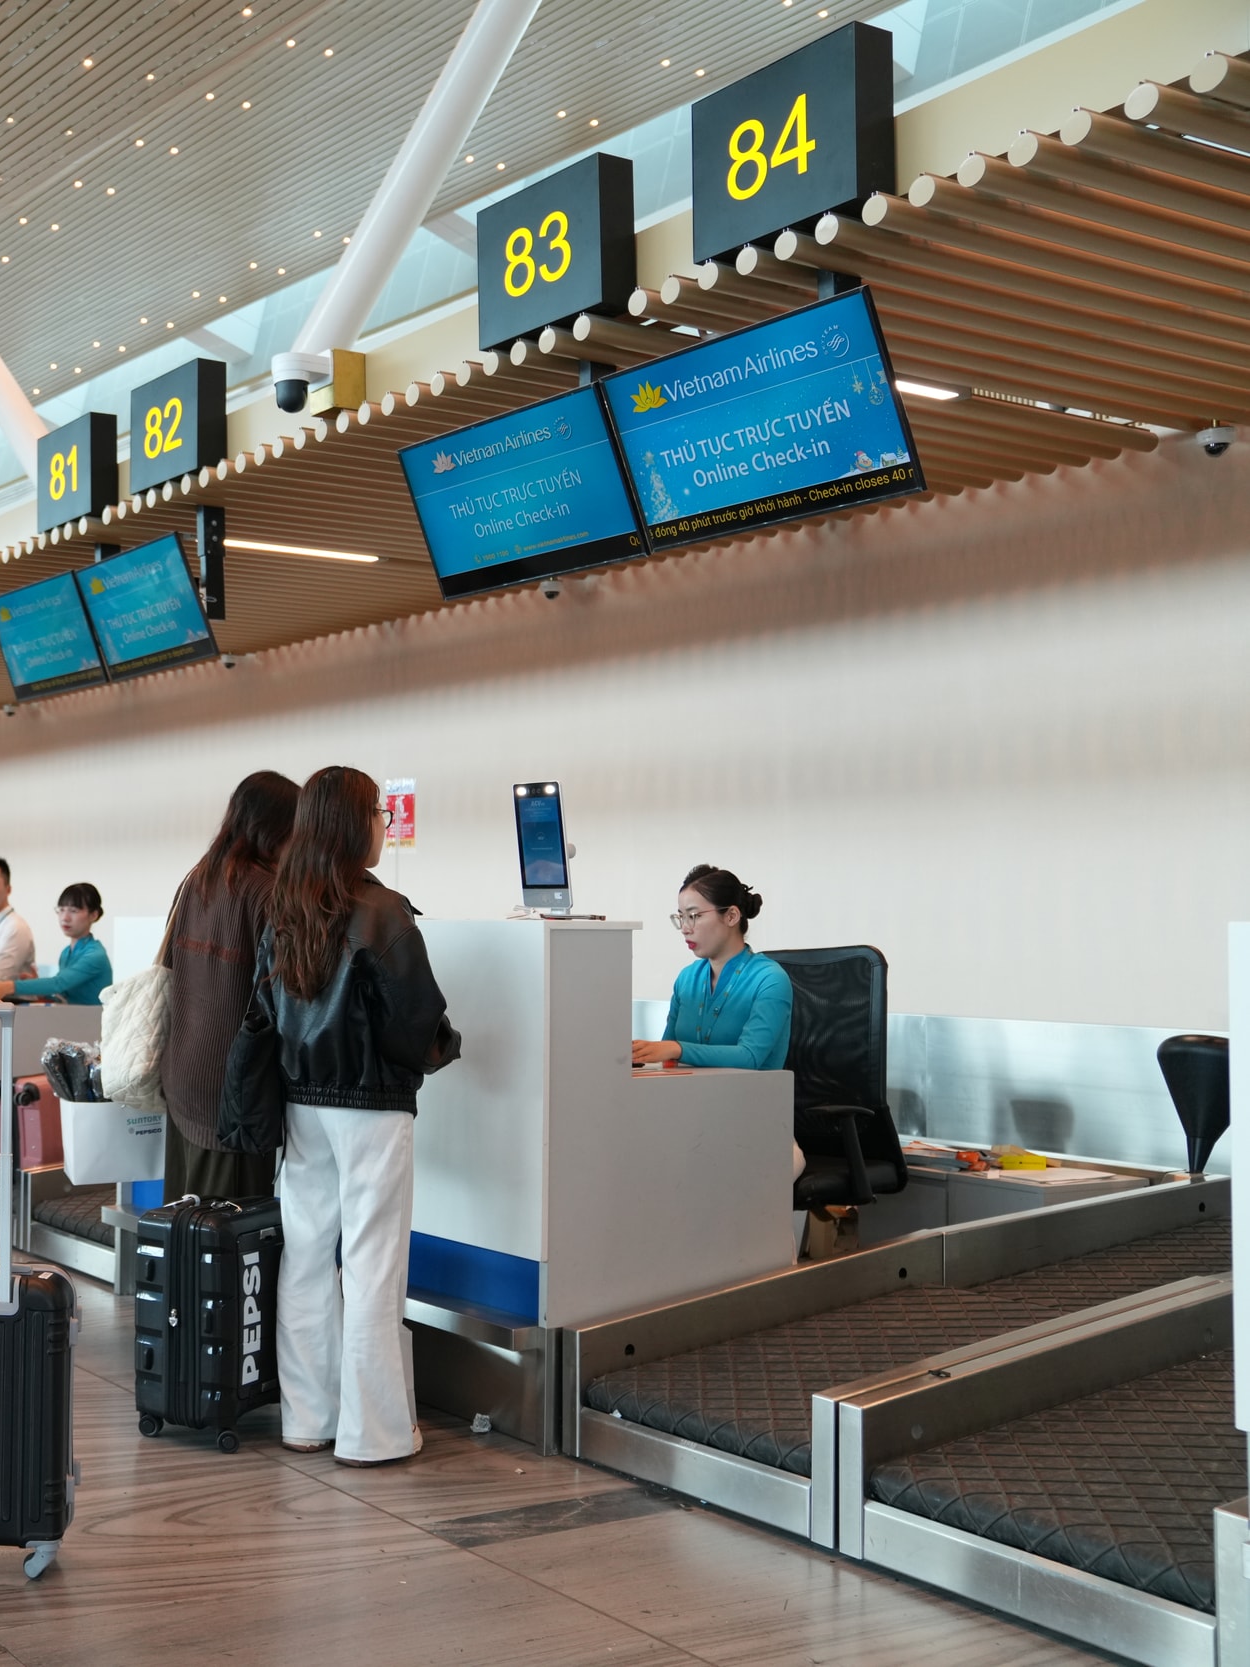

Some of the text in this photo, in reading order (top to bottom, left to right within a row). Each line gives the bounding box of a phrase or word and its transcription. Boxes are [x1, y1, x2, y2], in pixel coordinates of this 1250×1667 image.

[727, 93, 816, 201] 84
[503, 211, 572, 298] 83
[664, 341, 818, 402] Vietnam Airlines
[144, 397, 183, 459] 82
[453, 442, 505, 466] Vietnam
[505, 426, 552, 452] Airlines
[660, 397, 851, 468] THỦ TỤC TRỰC TUYẾN
[49, 444, 78, 500] 81
[449, 467, 582, 519] THỦ TỤC TRỰC TUYẾN
[693, 438, 831, 487] Online Check-in
[474, 502, 571, 538] Online Check-in
[655, 525, 678, 538] đóng
[678, 520, 690, 532] 40
[691, 516, 712, 532] phút
[712, 510, 738, 523] trước
[777, 494, 802, 509] hành
[809, 482, 853, 501] Check-in
[855, 474, 890, 490] closes
[892, 468, 906, 480] 40
[241, 1251, 261, 1386] PEPSI
